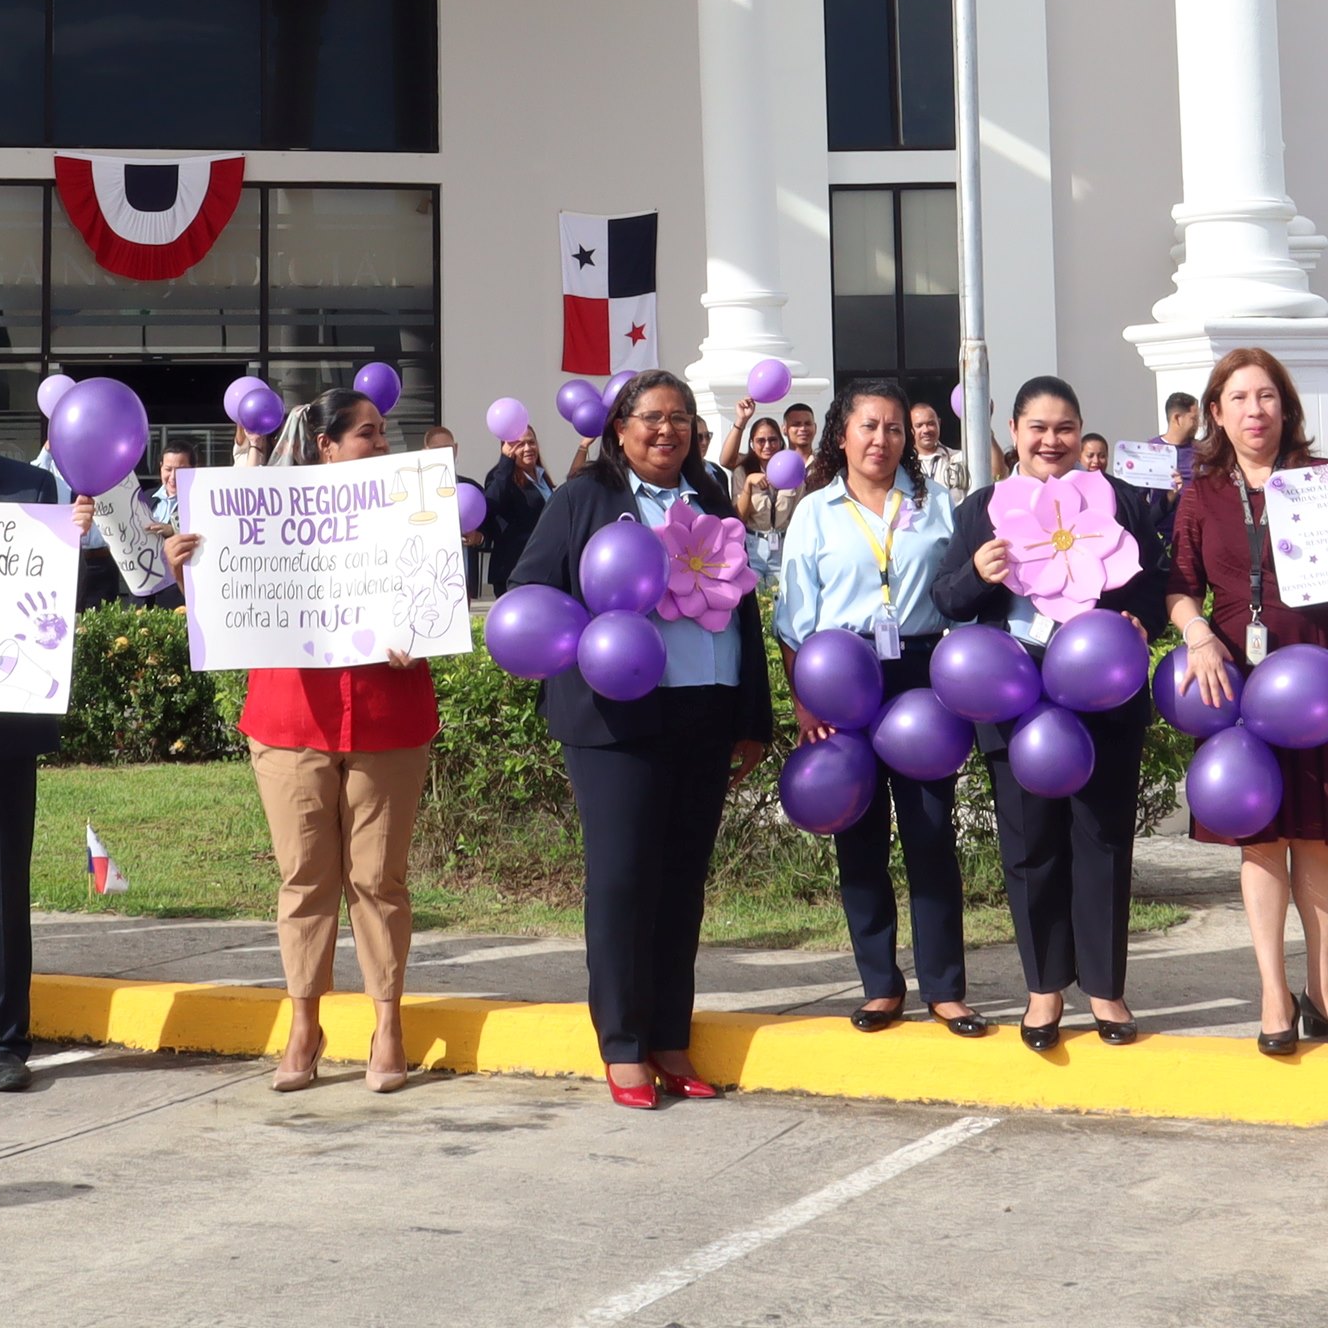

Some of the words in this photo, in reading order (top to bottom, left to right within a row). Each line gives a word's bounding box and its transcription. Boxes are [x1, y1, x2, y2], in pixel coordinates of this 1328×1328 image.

[210, 487, 283, 516] UNIDAD
[289, 479, 394, 517] REGIONAL
[239, 517, 266, 545] DE
[281, 510, 360, 546] COCLÉ
[26, 547, 45, 577] la
[218, 546, 337, 580] Comprometidos
[344, 551, 370, 570] con
[374, 543, 388, 566] la
[221, 576, 303, 600] eliminación
[307, 576, 324, 600] de
[329, 575, 342, 599] la
[225, 603, 271, 628] contra
[276, 603, 289, 628] la
[299, 604, 367, 632] mujer
